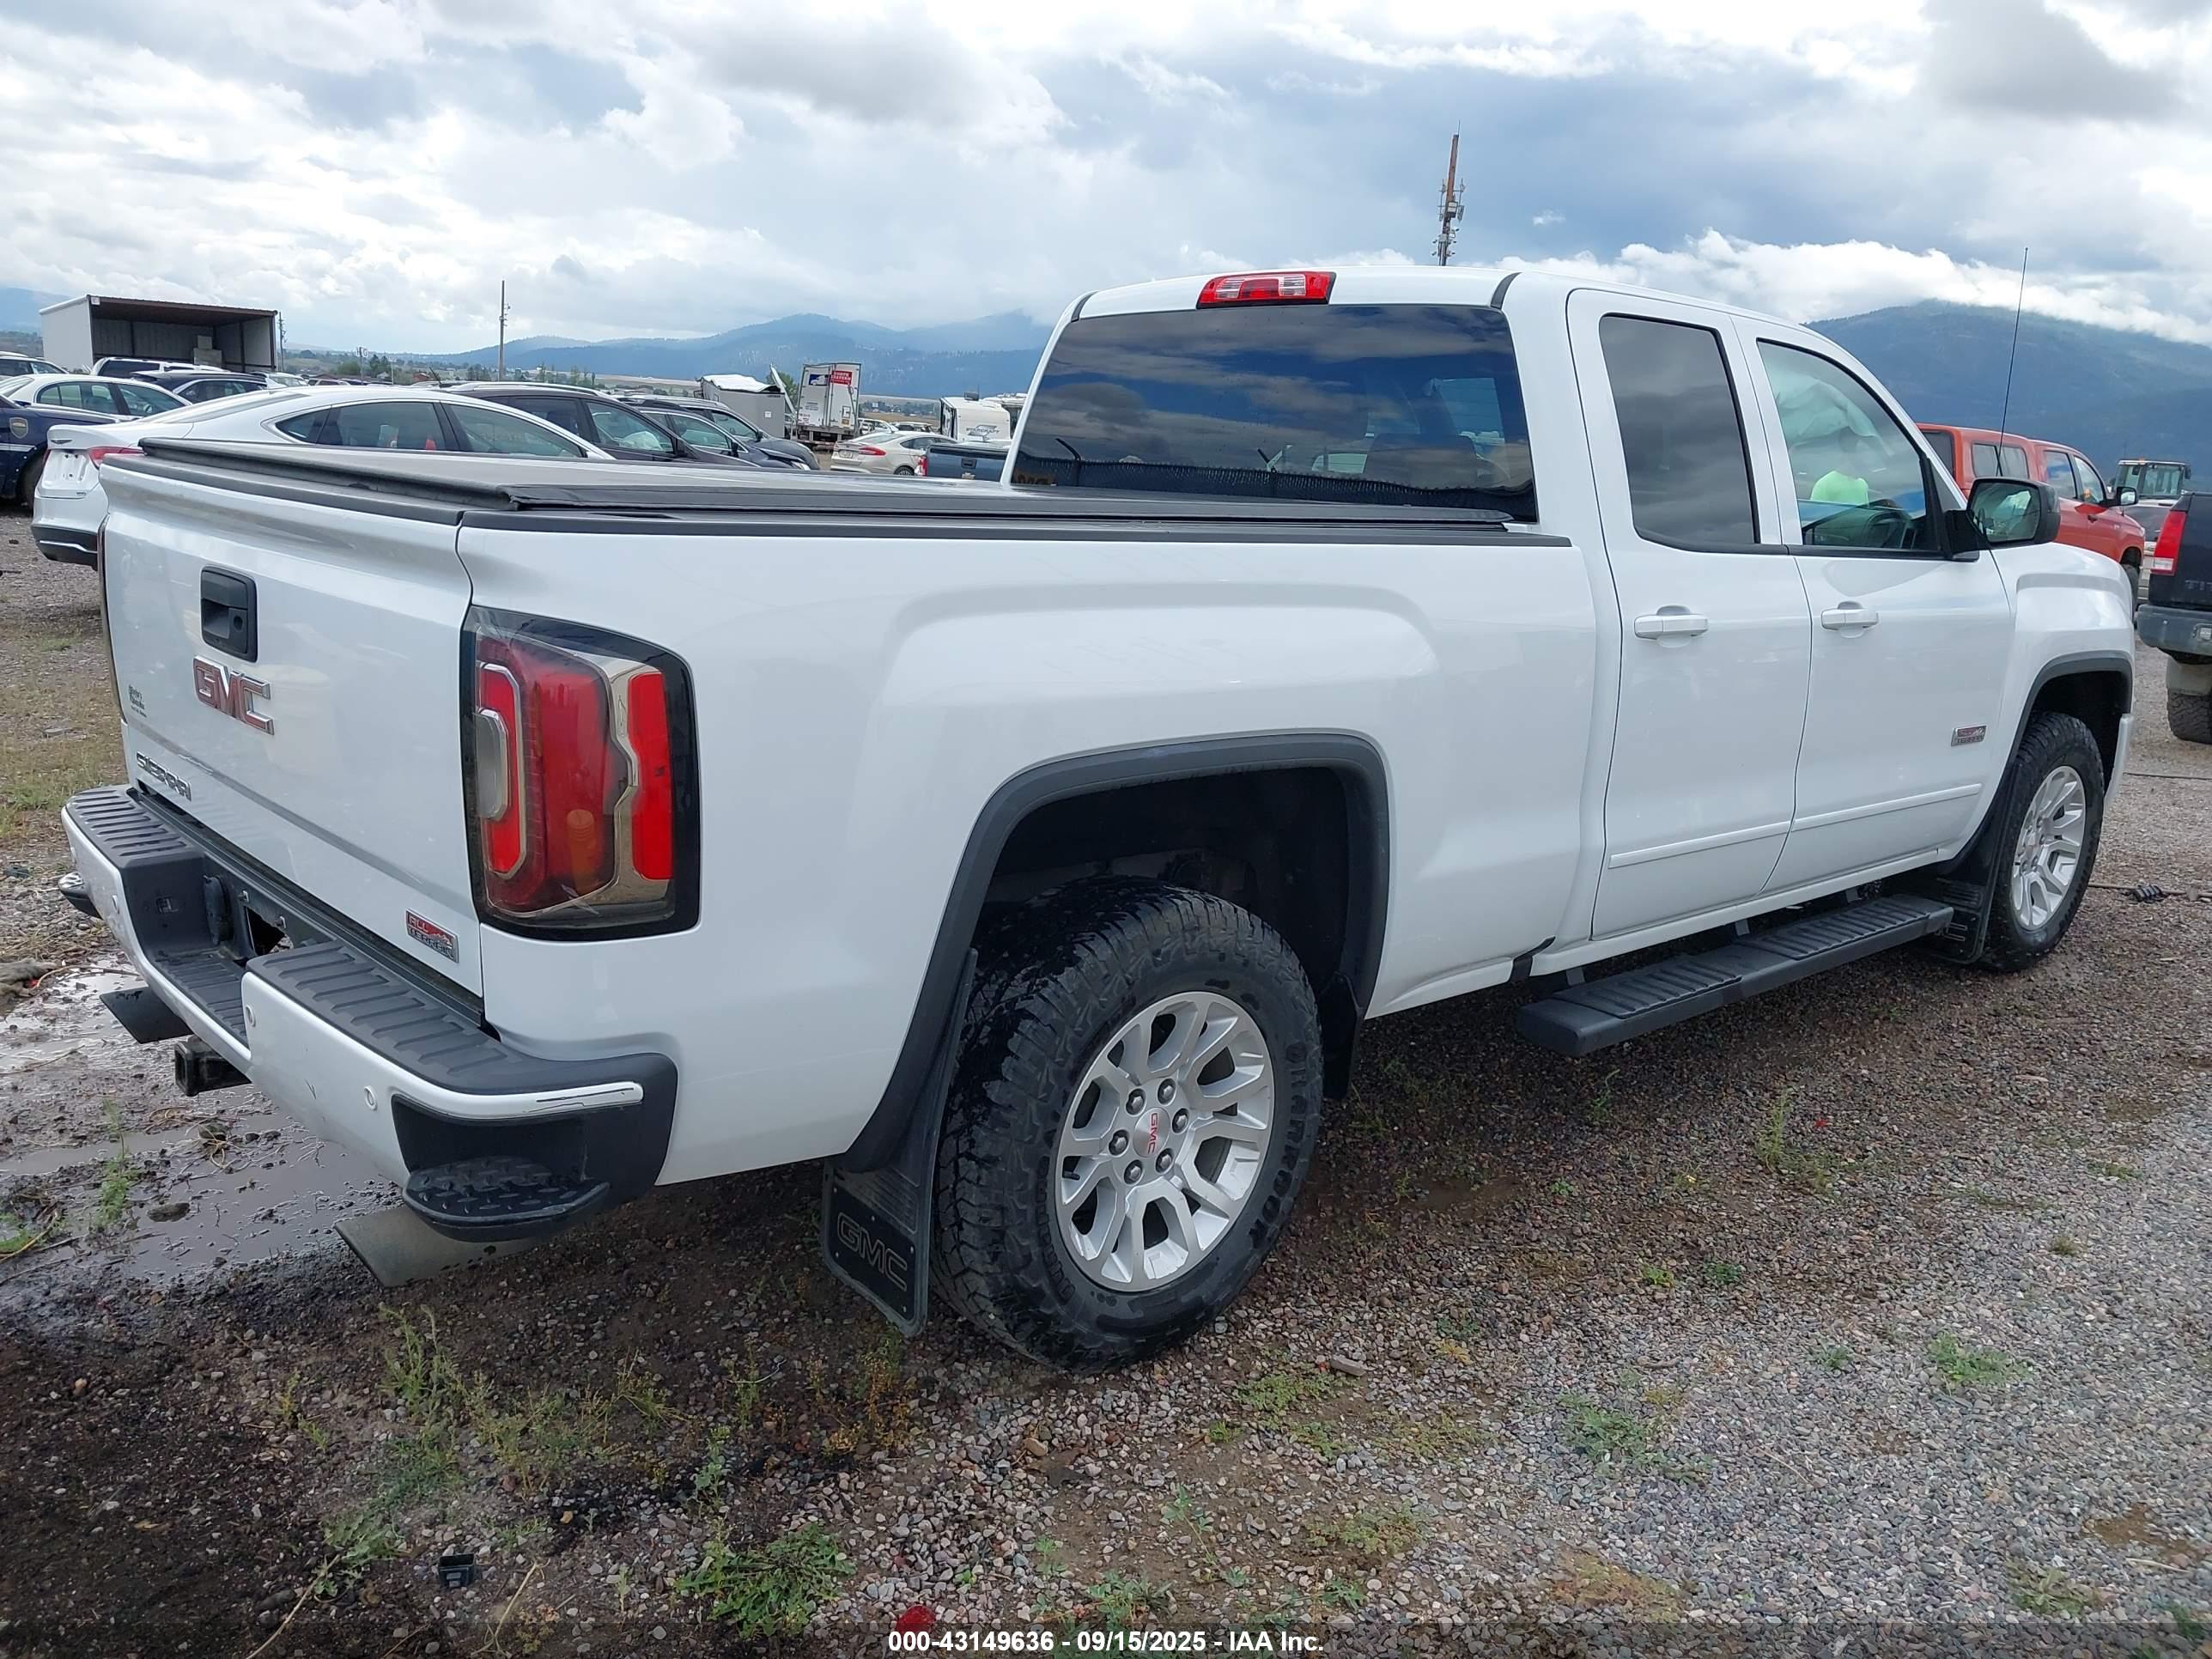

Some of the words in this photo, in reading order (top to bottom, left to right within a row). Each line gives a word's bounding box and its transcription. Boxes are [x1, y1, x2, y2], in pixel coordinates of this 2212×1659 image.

[192, 655, 275, 736] GMC
[137, 750, 192, 802] SIERRA
[408, 927, 454, 959] TERRAIN
[409, 915, 430, 933] ALL
[1148, 1113, 1158, 1155] GMC
[837, 1212, 908, 1292] GMC
